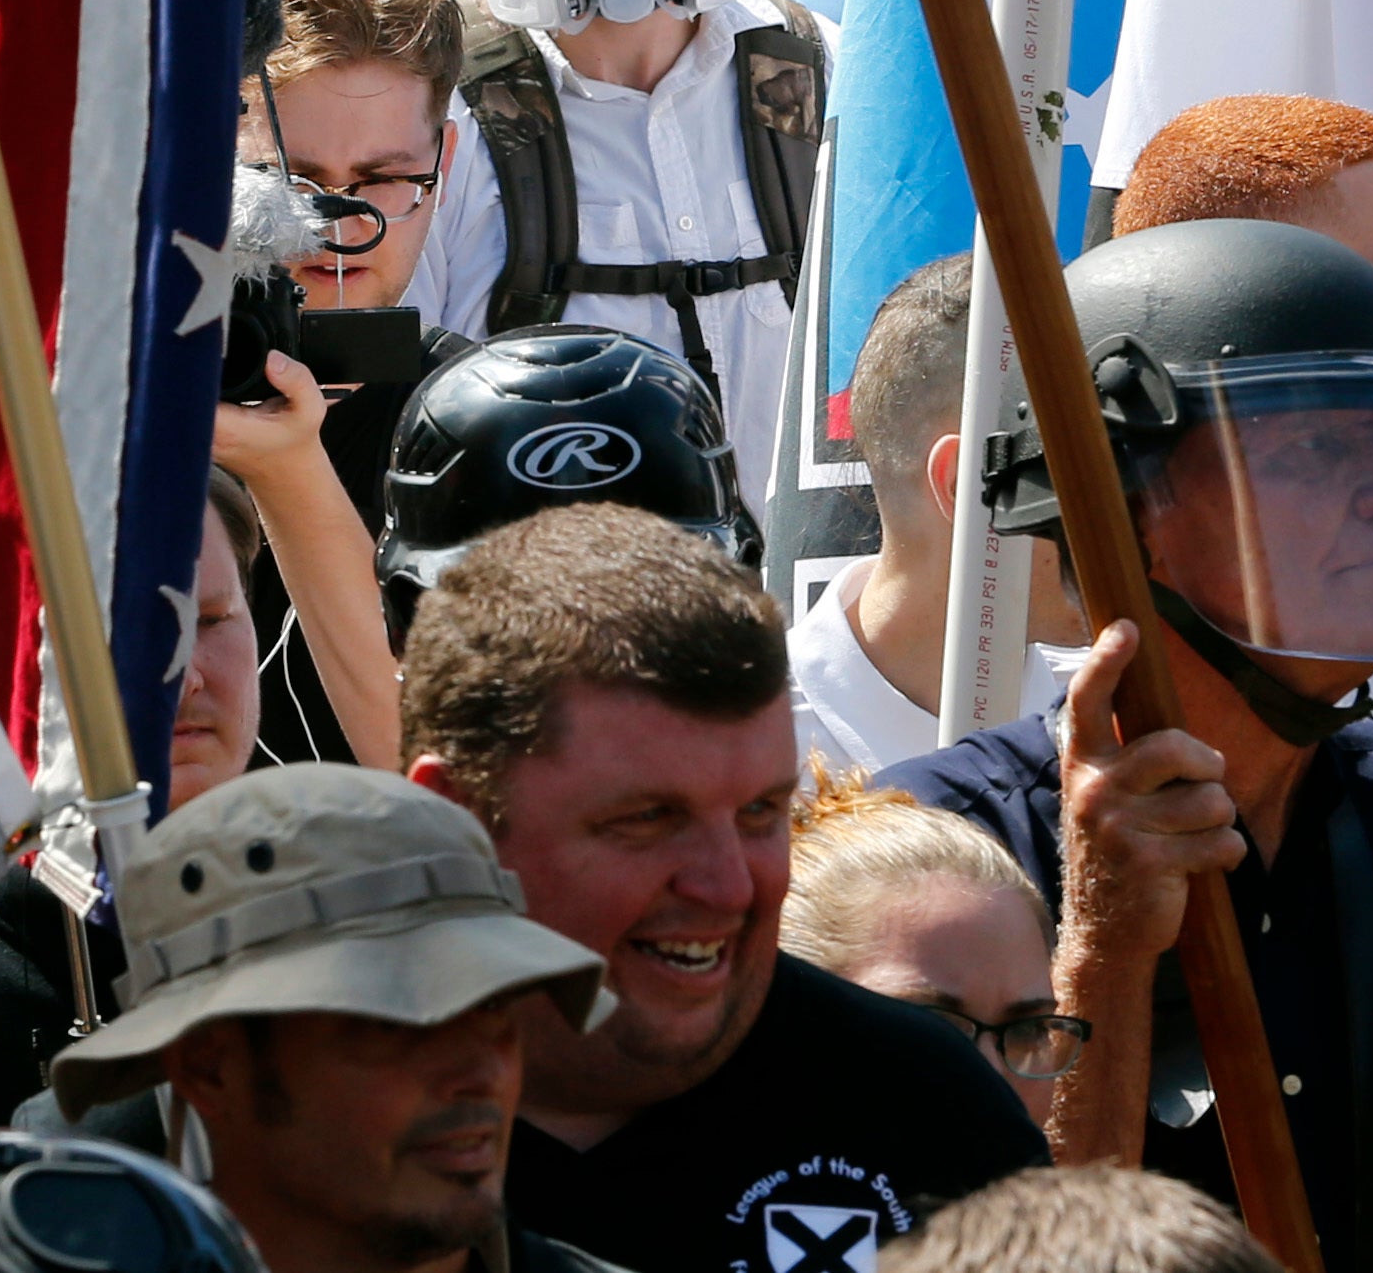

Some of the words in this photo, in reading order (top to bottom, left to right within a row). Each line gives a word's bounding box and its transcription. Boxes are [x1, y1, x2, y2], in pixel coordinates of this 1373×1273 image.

[1019, 69, 1035, 114] U.S.A.
[982, 575, 996, 599] PSI
[980, 605, 994, 630] 330
[978, 635, 992, 653] PR
[976, 658, 990, 688] 1120
[973, 696, 987, 721] PVC
[725, 1170, 790, 1225] League
[798, 1154, 823, 1176] of
[829, 1156, 866, 1182] the
[870, 1173, 913, 1233] South
